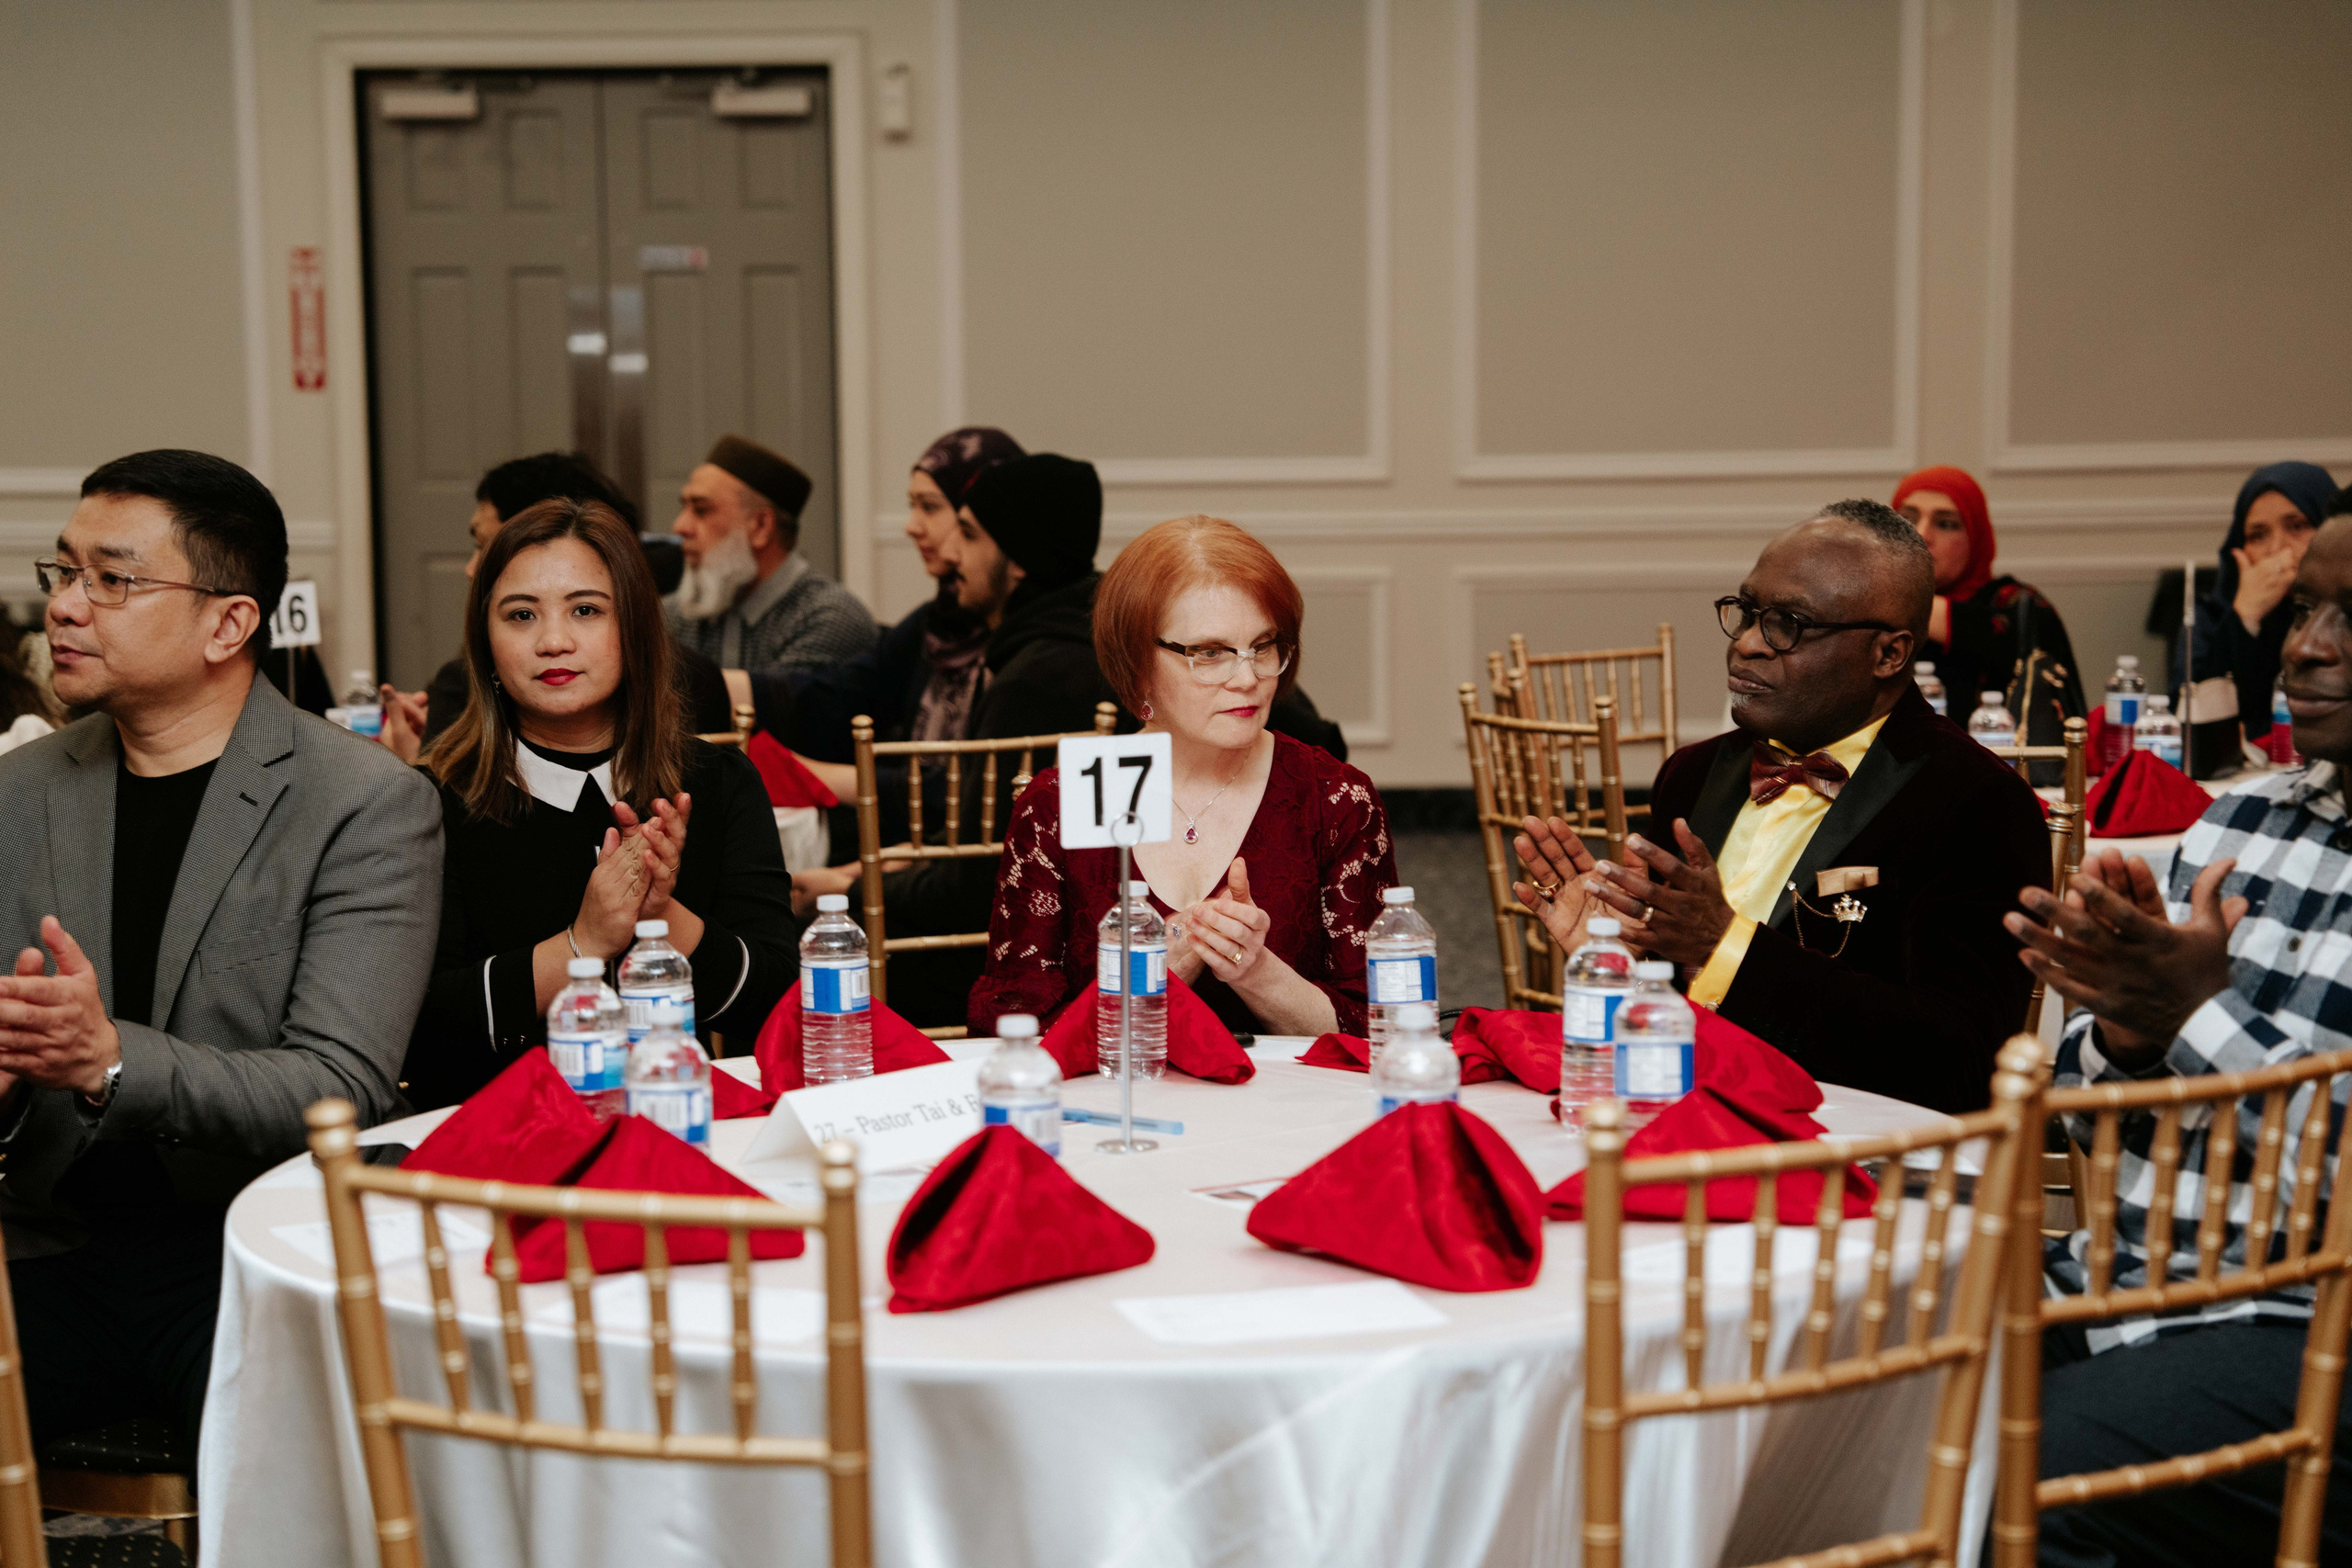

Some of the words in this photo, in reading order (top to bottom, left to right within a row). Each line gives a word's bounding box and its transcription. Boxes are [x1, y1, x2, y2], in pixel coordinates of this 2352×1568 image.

[276, 595, 307, 635] 16
[1080, 755, 1153, 827] 17
[814, 1122, 838, 1144] 27
[855, 1110, 913, 1135] Pastor
[912, 1102, 946, 1123] Tai
[949, 1099, 966, 1115] &
